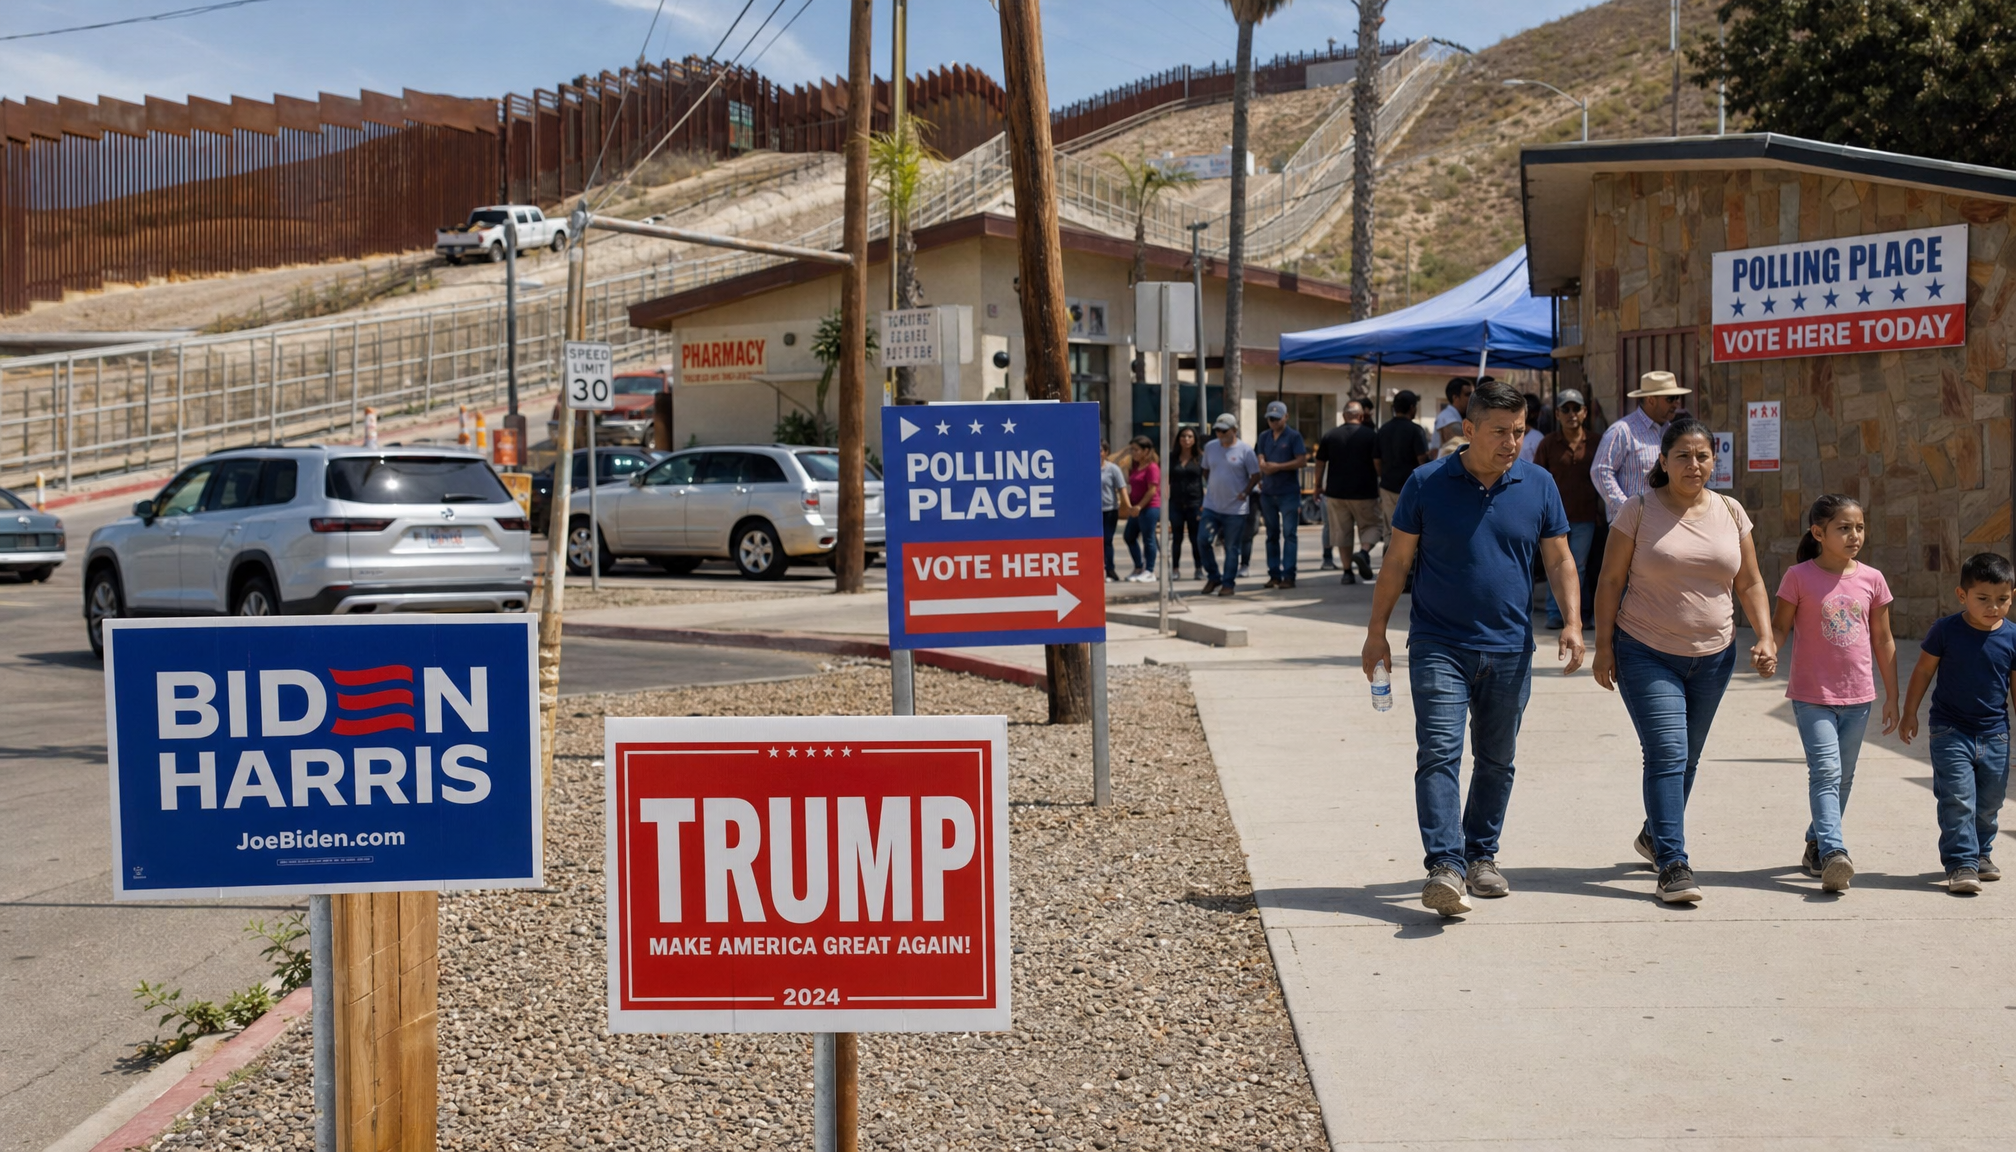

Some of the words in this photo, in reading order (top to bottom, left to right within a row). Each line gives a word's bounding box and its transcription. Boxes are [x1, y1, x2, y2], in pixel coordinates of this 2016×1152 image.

[1732, 246, 1841, 293] POLLING
[1848, 235, 1943, 282] PLACE
[1722, 327, 1780, 354] VOTE
[1786, 322, 1851, 349] HERE
[1859, 312, 1952, 343] TODAY
[569, 348, 609, 360] SPEED
[573, 363, 605, 374] LIMIT
[682, 339, 765, 369] PHARMACY
[572, 378, 608, 402] 30
[906, 449, 1055, 483] POLLING
[908, 485, 1056, 522] PLACE
[911, 554, 992, 581] VOTE
[1001, 551, 1080, 578] HERE
[156, 664, 489, 740] BIDEN
[159, 743, 492, 811] HARRIS
[236, 829, 405, 851] JoeBiden.com
[639, 795, 976, 924] TRUMP
[649, 937, 711, 956] MAKE
[718, 936, 817, 955] AMERICA
[823, 936, 892, 955] GREAT
[897, 935, 971, 955] AGAIN!
[783, 988, 840, 1006] 2024
